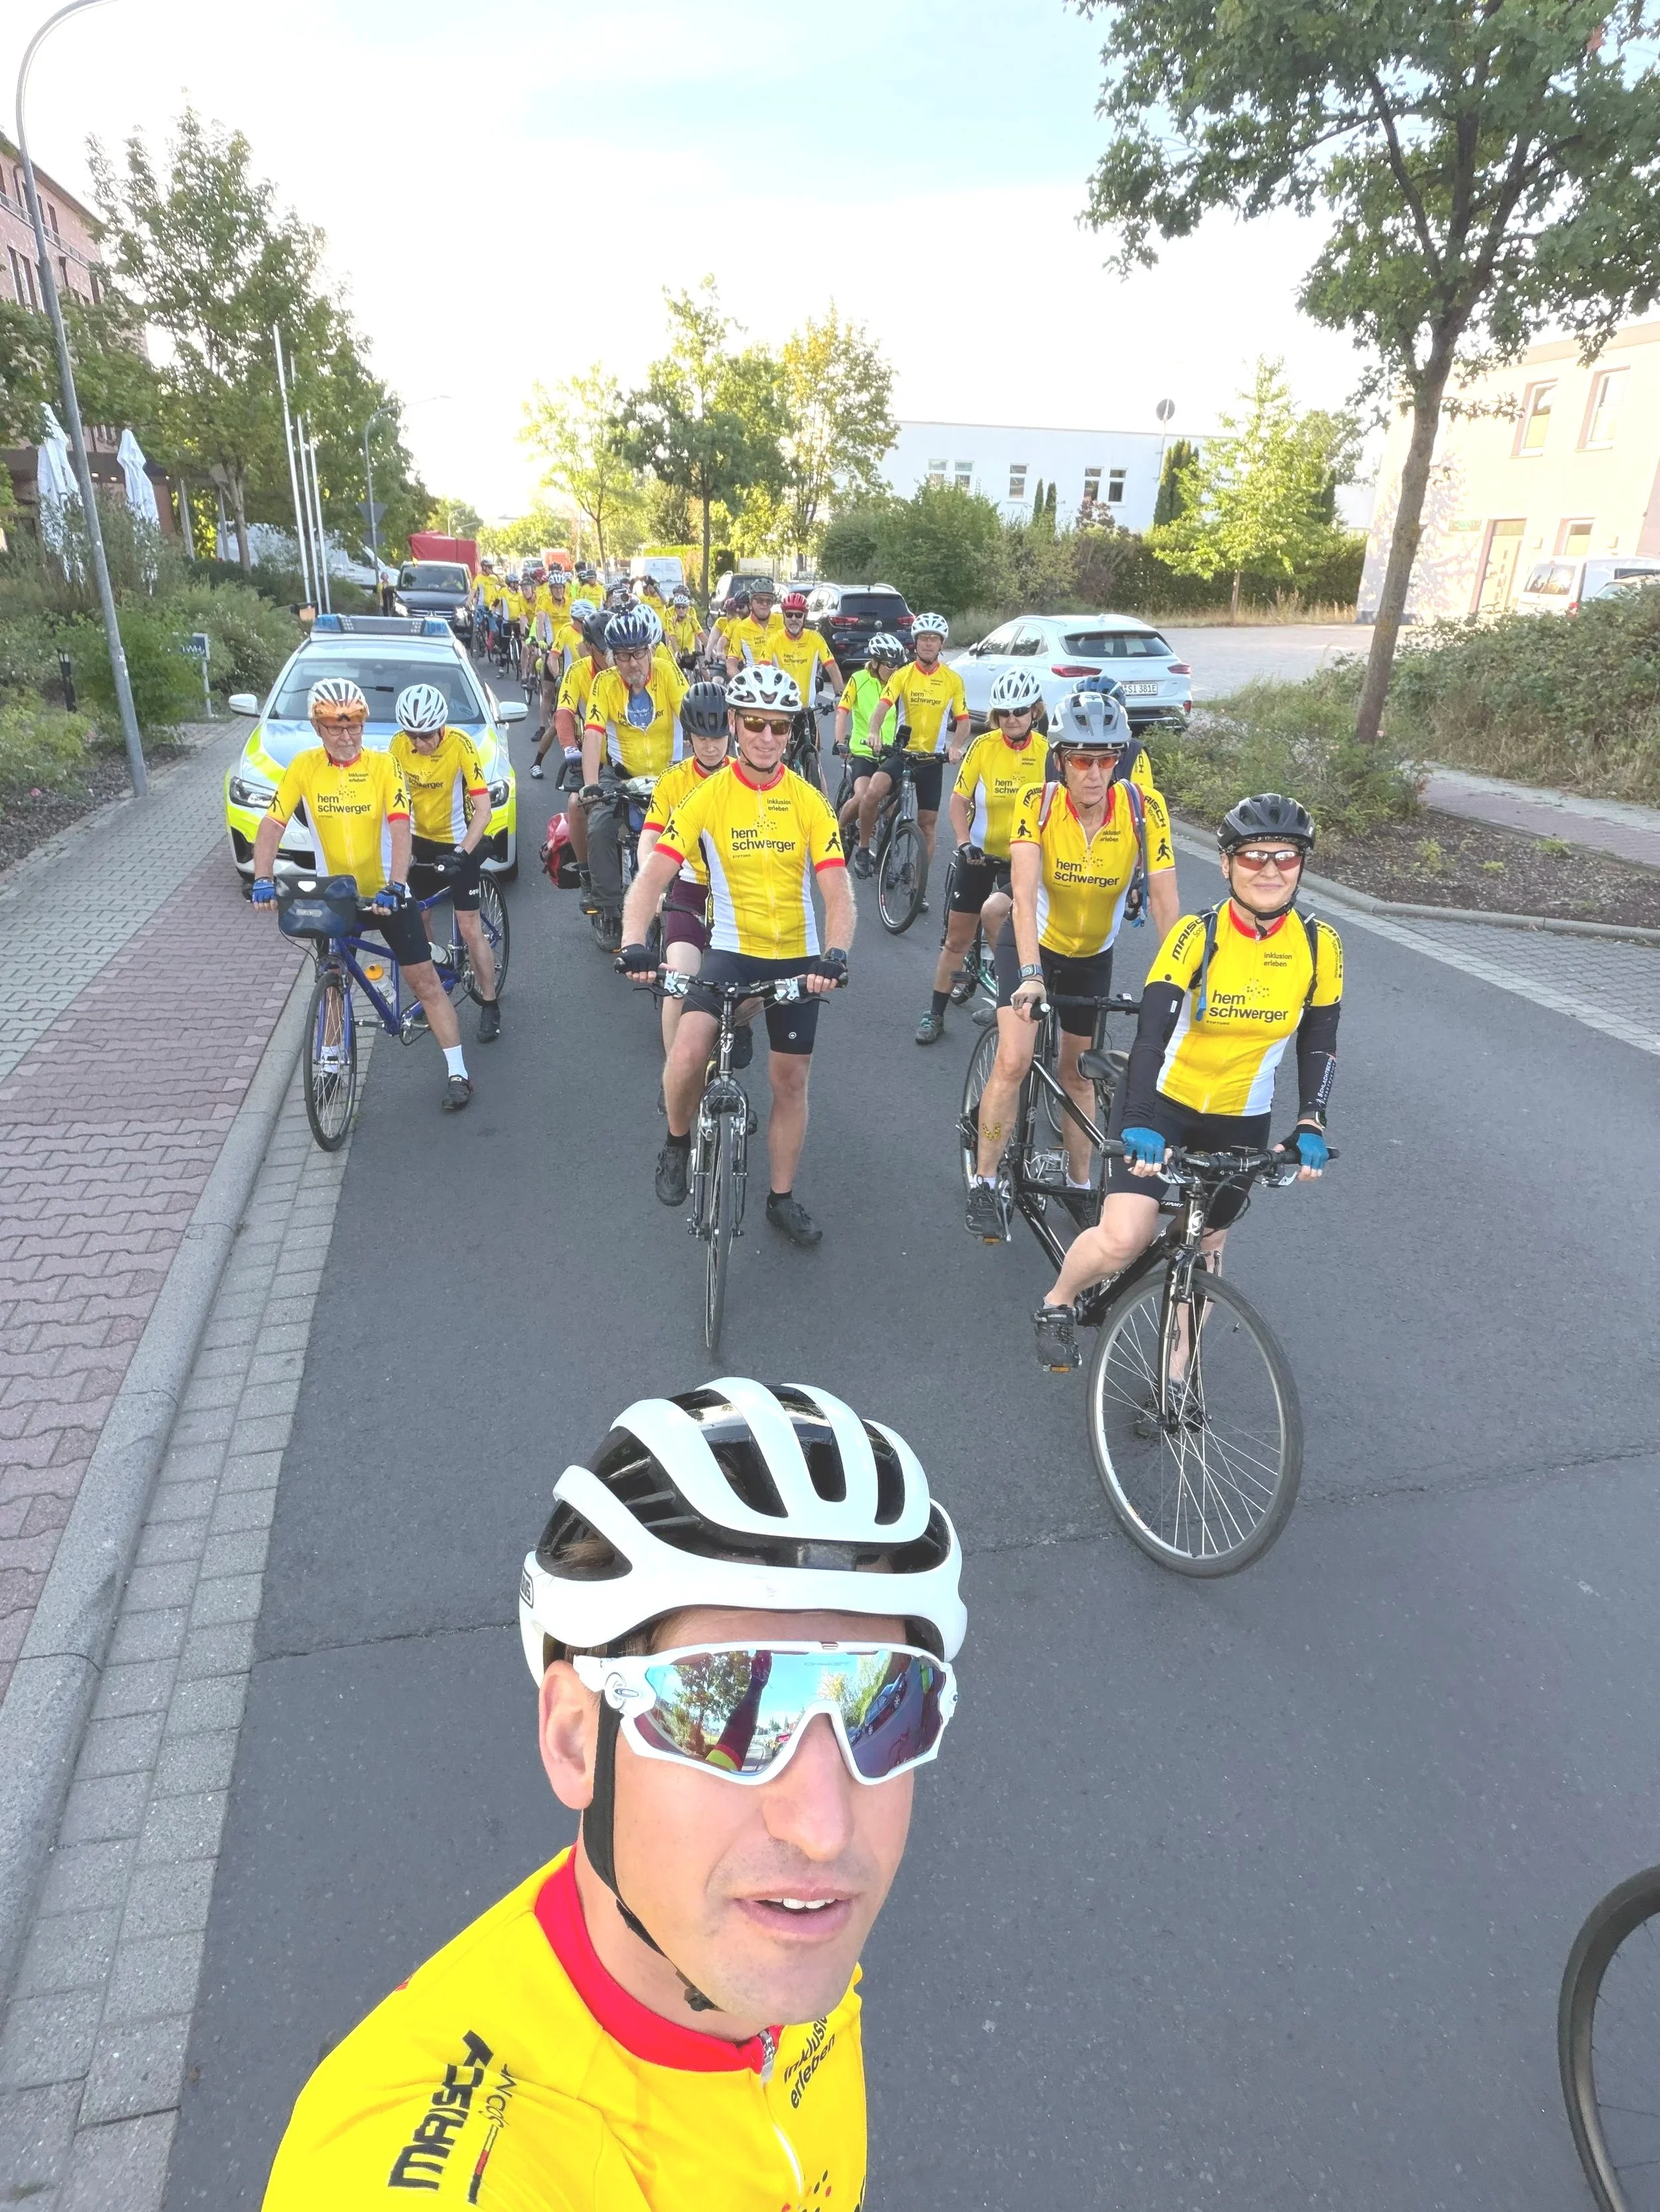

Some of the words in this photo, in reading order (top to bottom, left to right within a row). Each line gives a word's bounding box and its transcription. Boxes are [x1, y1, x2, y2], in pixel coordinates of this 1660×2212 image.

[317, 793, 339, 803] hem
[317, 803, 371, 815] schwerger
[1144, 795, 1167, 827] AISCH
[731, 827, 758, 839] hem
[732, 838, 796, 852] schwerger
[1056, 858, 1082, 872] hem
[1054, 871, 1120, 888] schwerger
[1171, 917, 1204, 961] MAISC
[1212, 989, 1246, 1005] hem
[1208, 1005, 1289, 1023] schwerger
[791, 2033, 835, 2109] erleben
